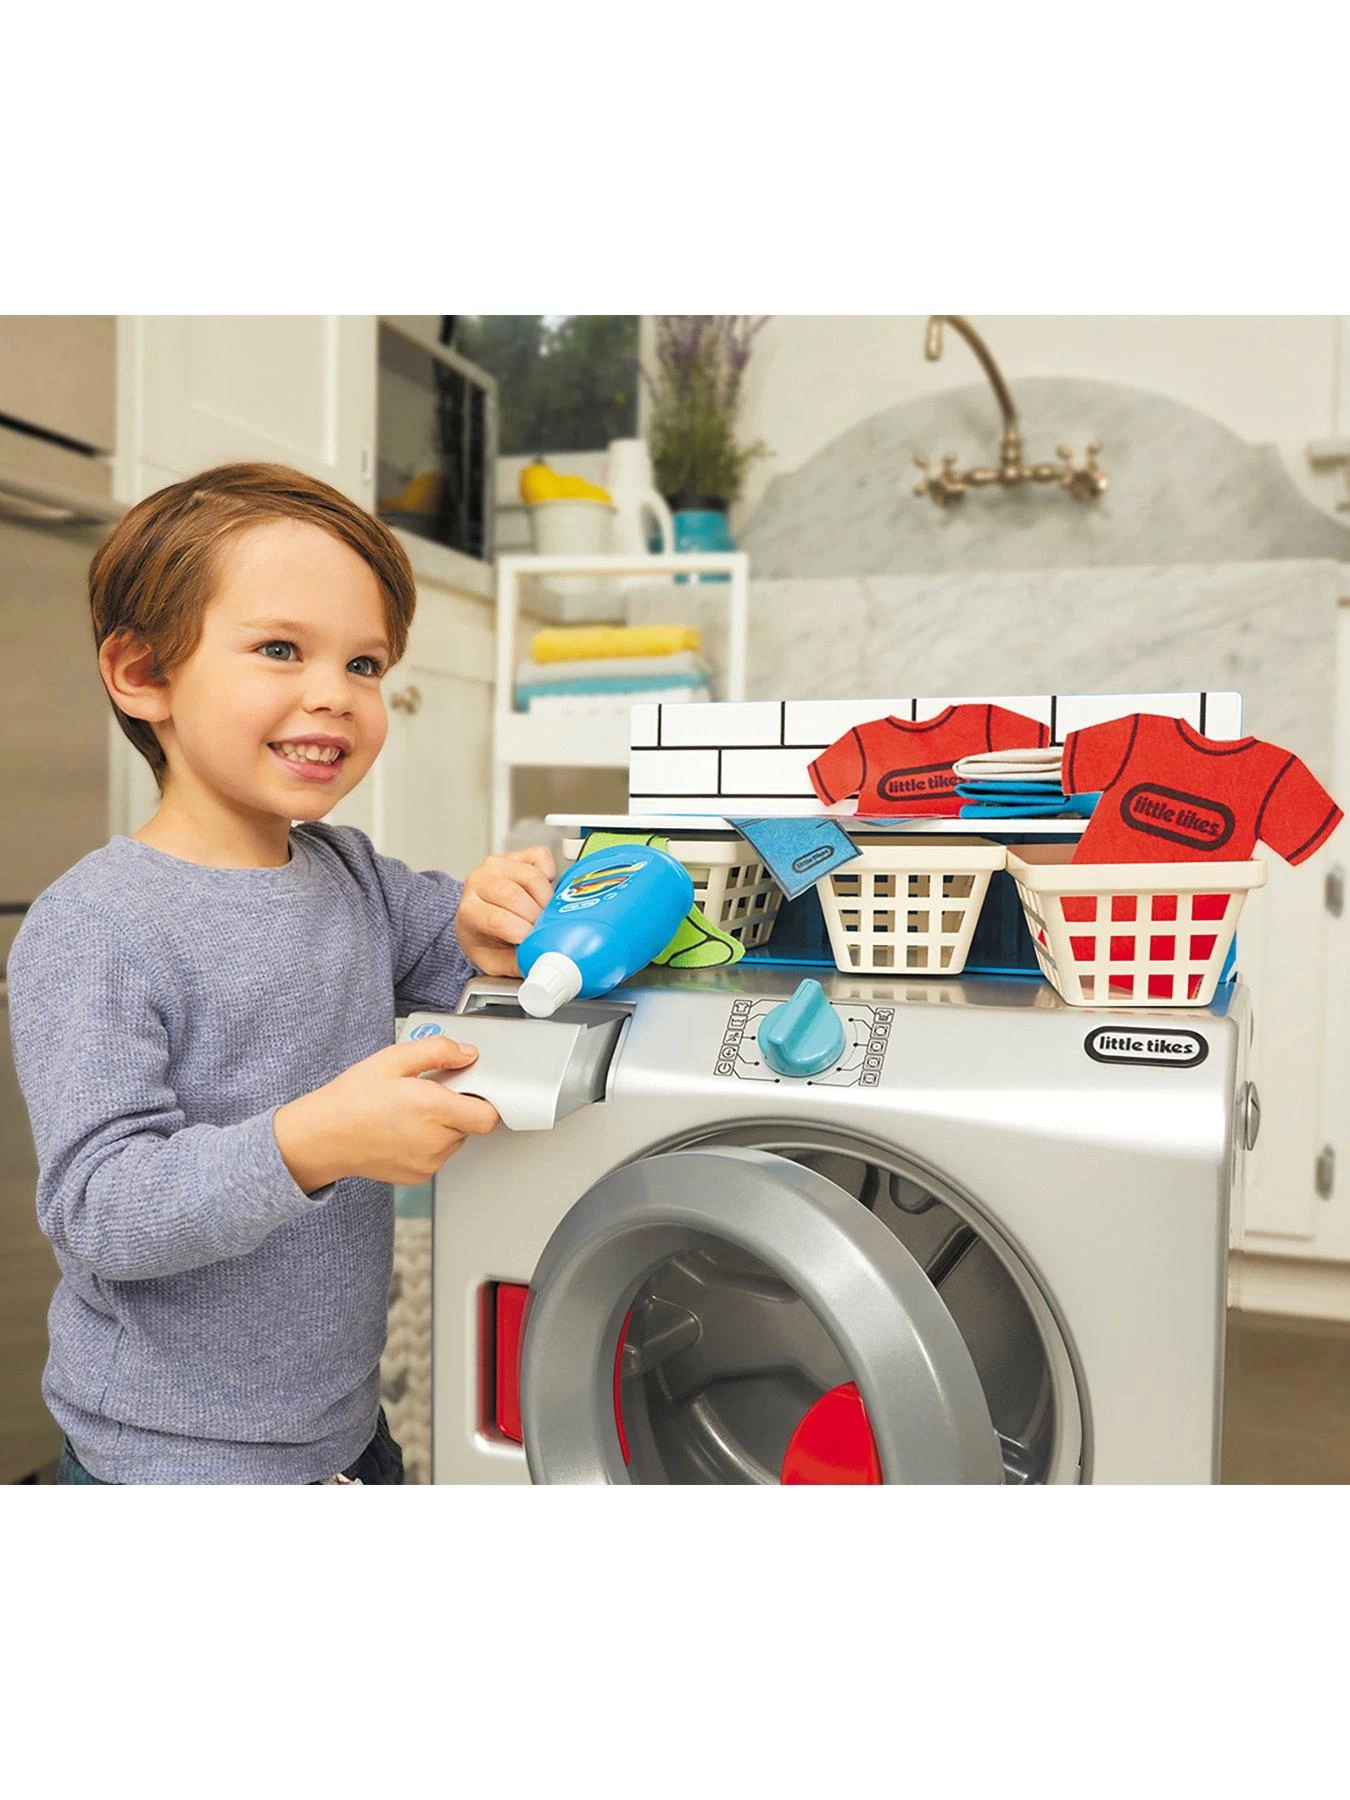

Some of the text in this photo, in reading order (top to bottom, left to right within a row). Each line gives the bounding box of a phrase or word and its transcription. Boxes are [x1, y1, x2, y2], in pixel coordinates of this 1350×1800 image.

[889, 778, 926, 793] little
[1133, 795, 1219, 837] little tikes
[1099, 1036, 1193, 1054] little tikes
